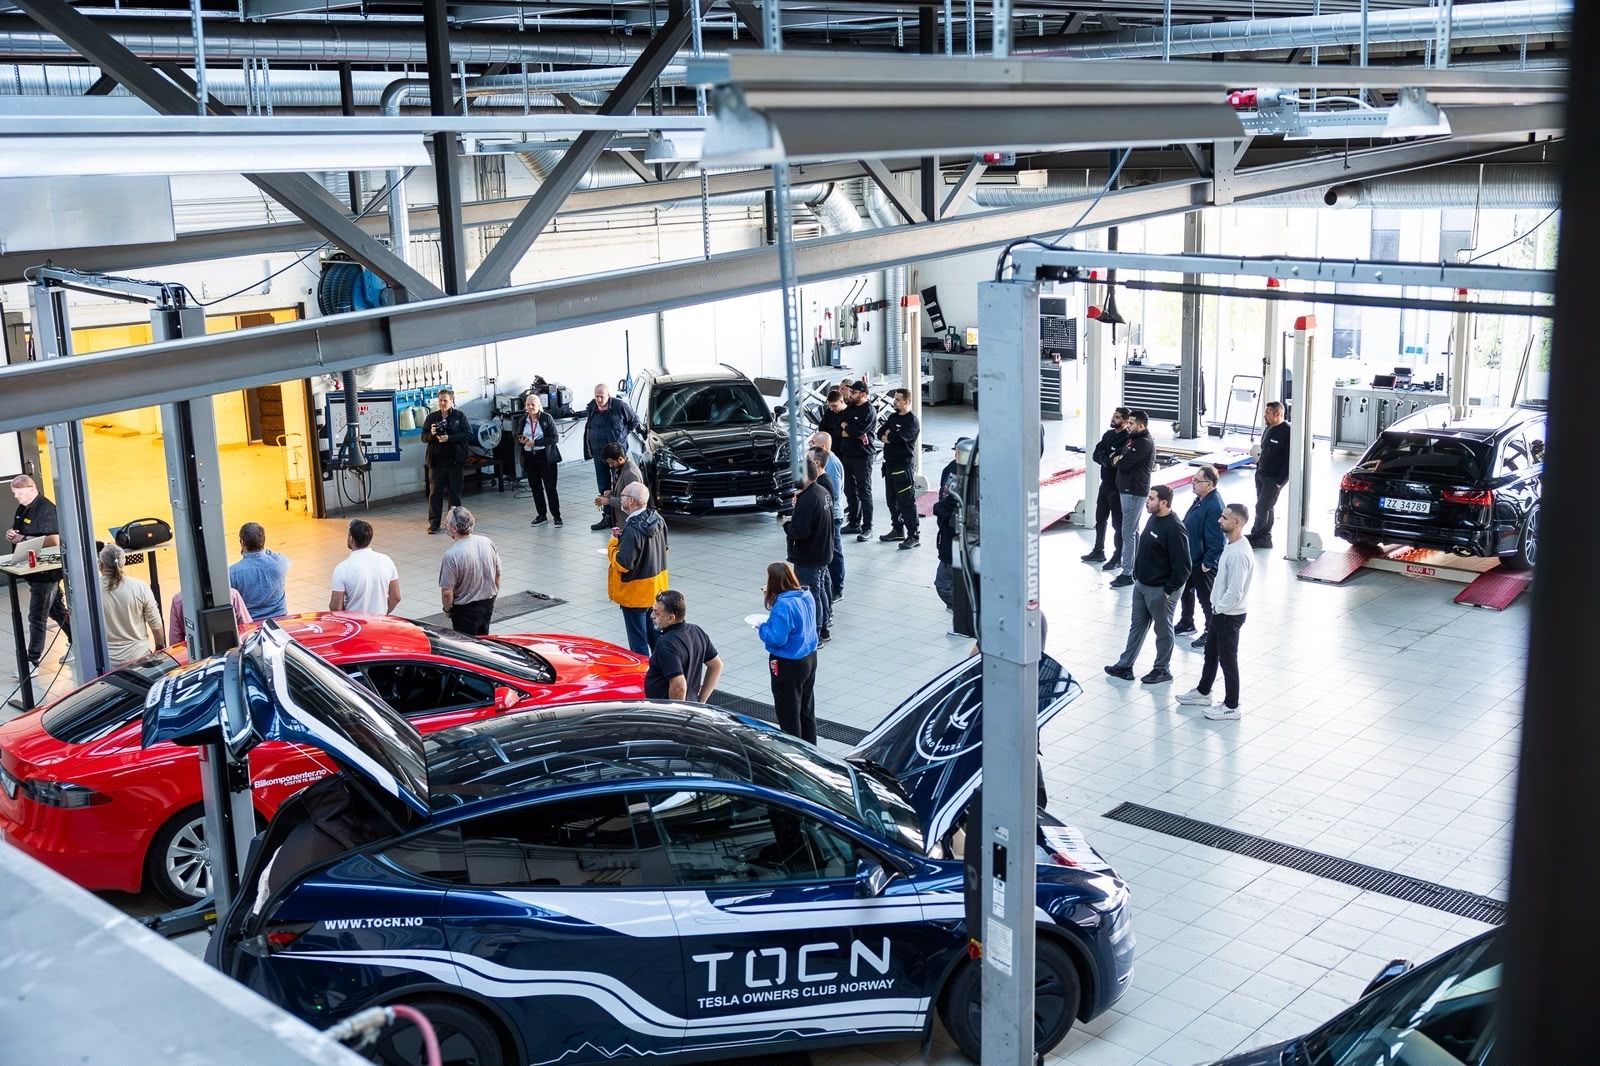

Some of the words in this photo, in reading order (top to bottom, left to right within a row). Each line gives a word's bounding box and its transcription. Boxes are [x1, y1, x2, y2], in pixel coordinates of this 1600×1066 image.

[1027, 490, 1038, 527] LIFT
[1387, 499, 1397, 508] ZZ
[1400, 501, 1427, 511] 34789
[1027, 531, 1038, 600] ROTARY
[254, 769, 327, 788] Bilkomponenter.no
[324, 917, 423, 930] WWW.TOCN.NO
[692, 936, 891, 992] TOCN
[697, 996, 740, 1009] TESLA
[742, 988, 799, 1004] OWNERS
[802, 984, 837, 998] CLUB
[840, 978, 895, 993] NORWAY
